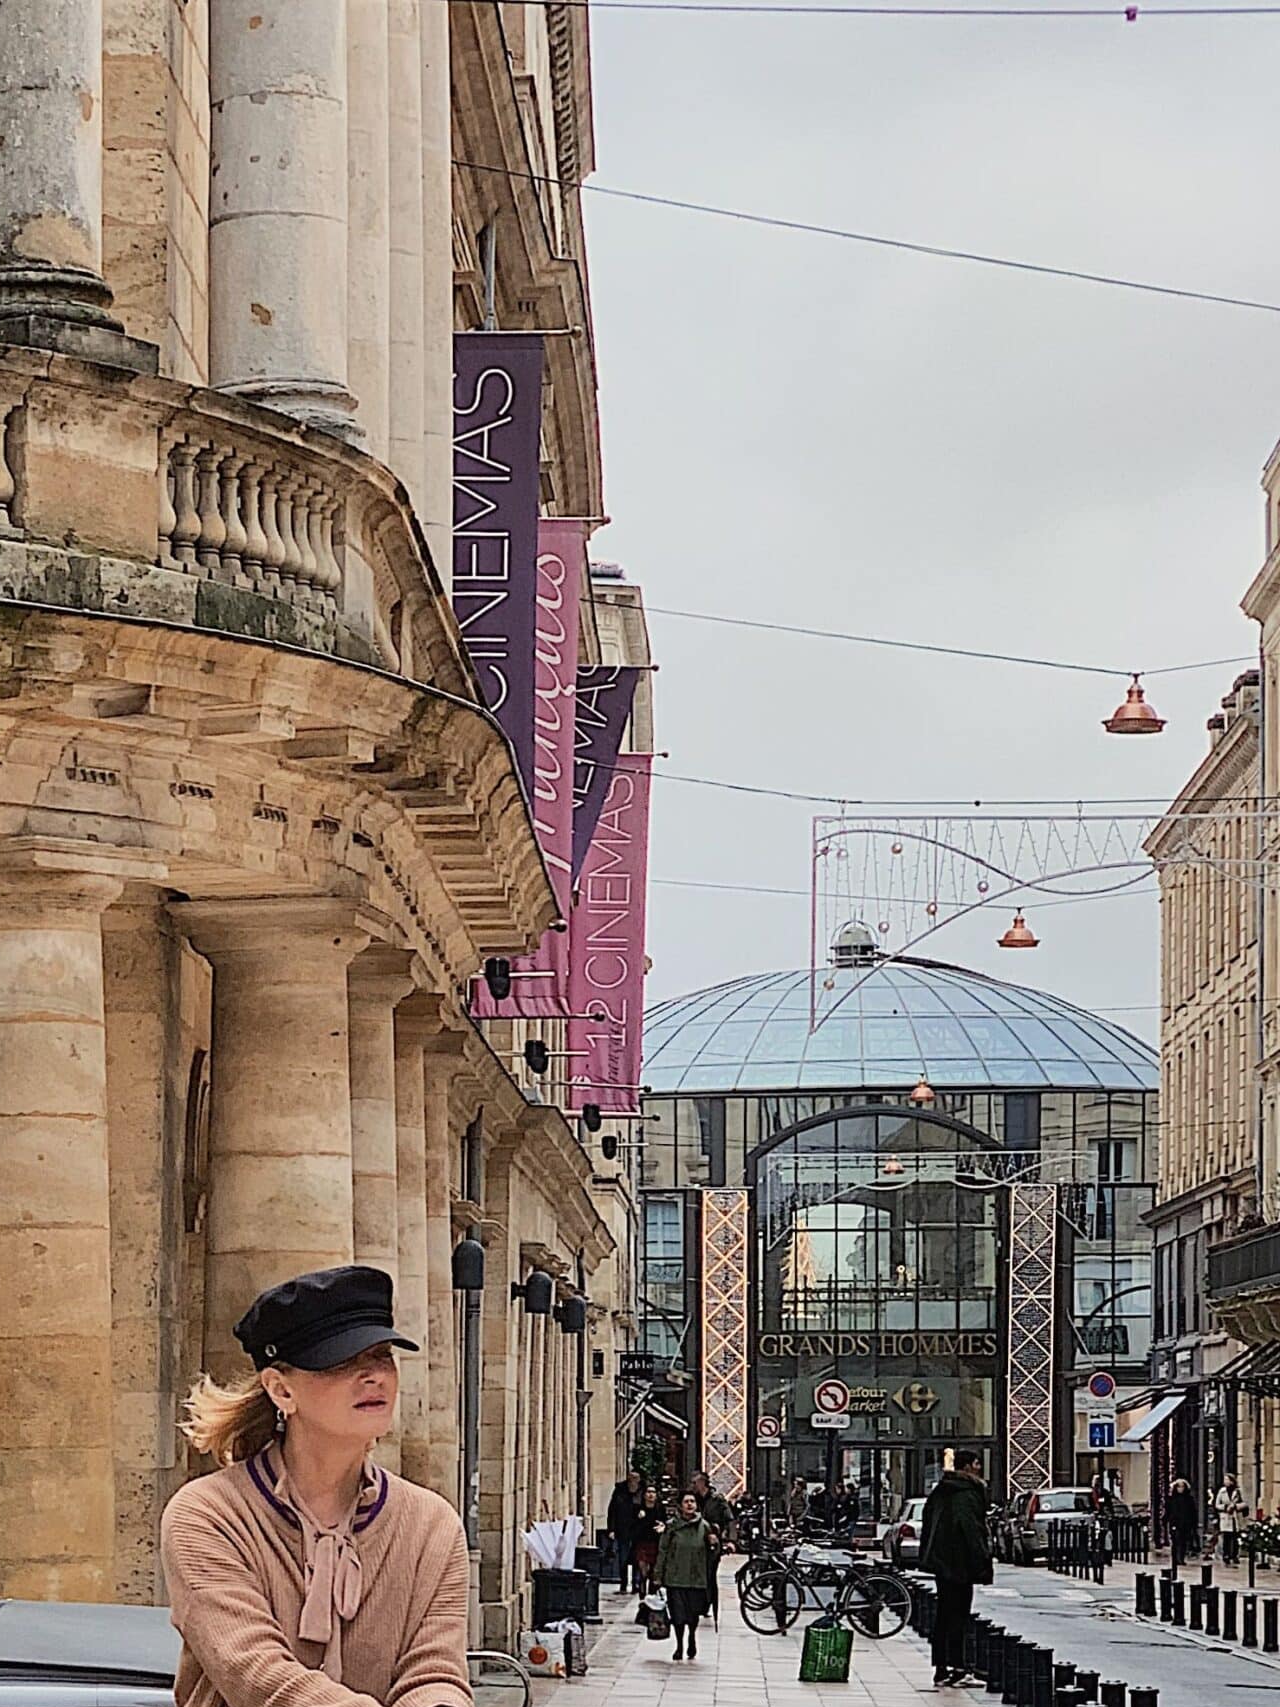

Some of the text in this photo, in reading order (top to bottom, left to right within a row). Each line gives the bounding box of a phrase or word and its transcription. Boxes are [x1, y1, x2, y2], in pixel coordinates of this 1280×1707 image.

[584, 999, 628, 1048] 12
[759, 1333, 997, 1357] GRANDS HOMMES
[622, 1359, 654, 1370] Pablo
[847, 1399, 887, 1412] arket
